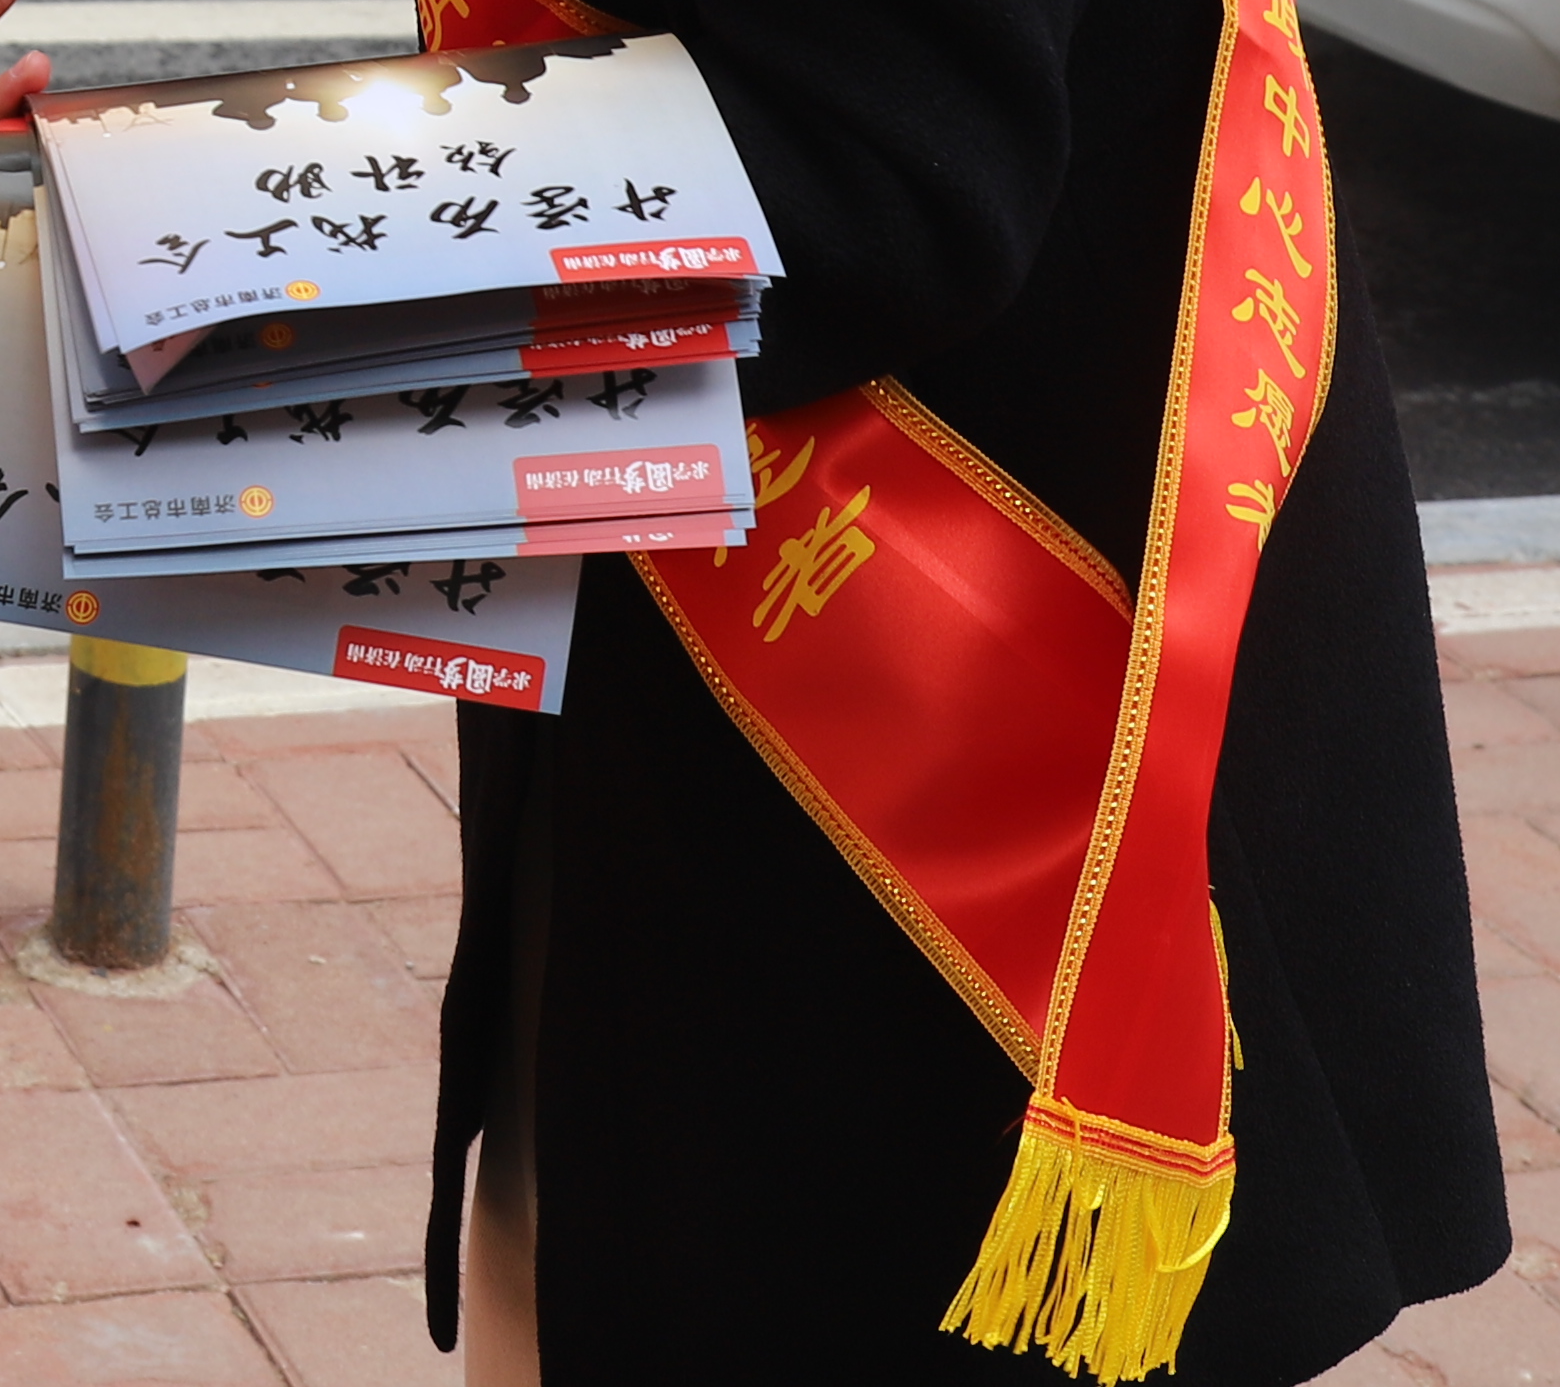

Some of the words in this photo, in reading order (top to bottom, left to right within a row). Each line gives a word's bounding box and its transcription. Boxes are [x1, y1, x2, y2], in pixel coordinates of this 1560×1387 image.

[254, 140, 517, 204] 领补助
[137, 214, 389, 275] 找工会
[143, 286, 283, 328] 济南市总工会
[525, 469, 580, 491] 在济南
[583, 460, 711, 495] 求学圆梦行动
[93, 494, 236, 524] 济南市总工会
[345, 642, 402, 670] 在济南
[403, 651, 533, 695] 求学圆梦行动
